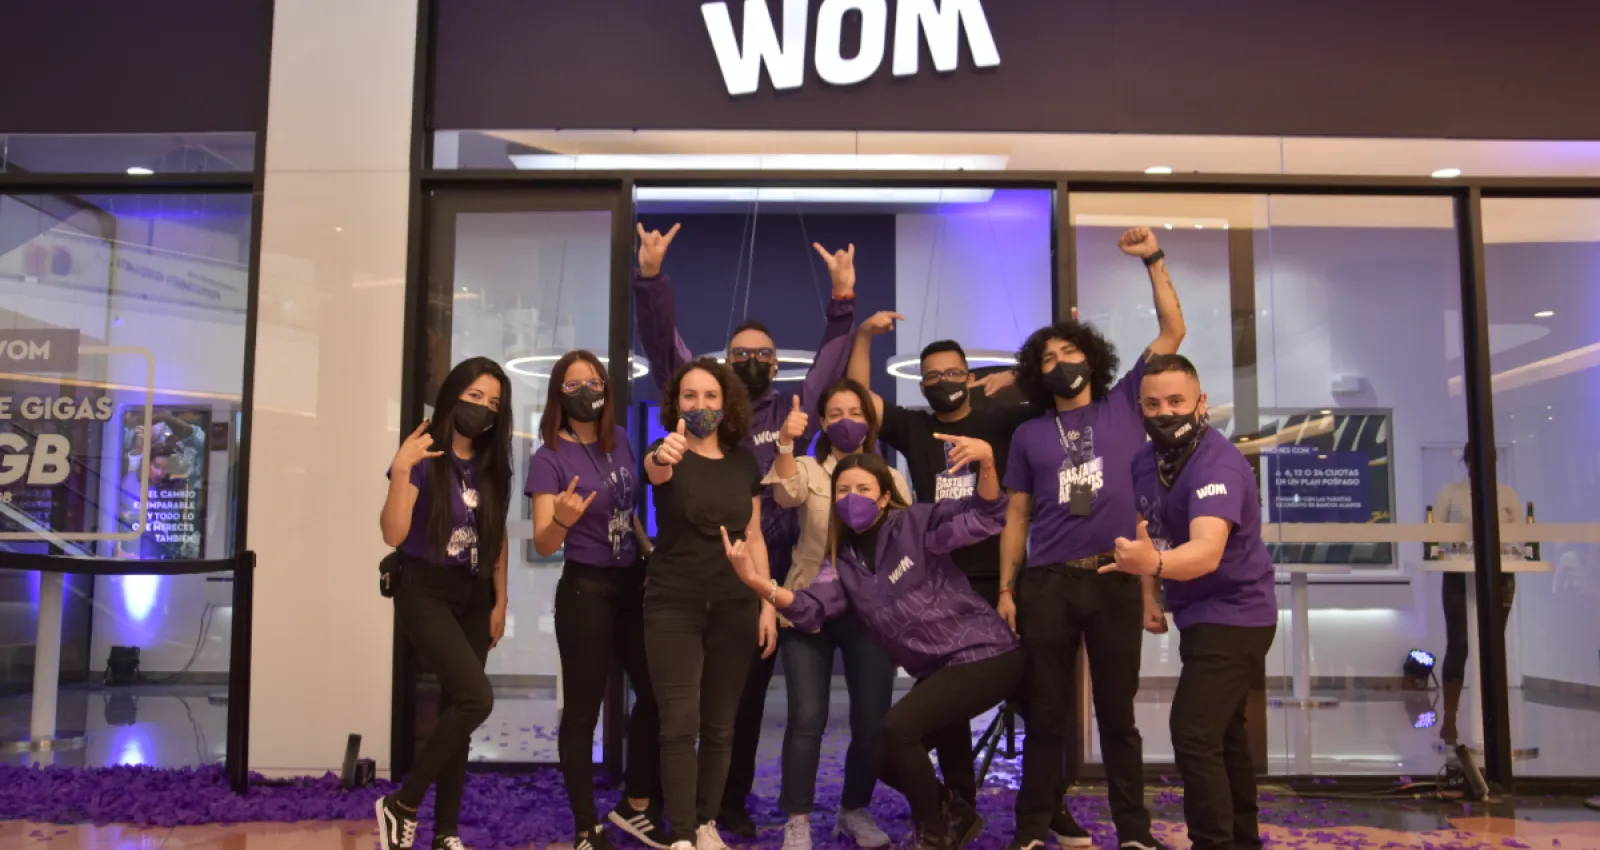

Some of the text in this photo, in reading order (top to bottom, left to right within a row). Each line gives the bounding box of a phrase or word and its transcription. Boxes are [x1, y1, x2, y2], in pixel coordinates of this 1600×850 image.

[701, 0, 1001, 95] WOM
[20, 395, 113, 421] GIGAS
[1174, 422, 1192, 439] WOM
[0, 433, 70, 486] GB
[1325, 468, 1359, 477] CUOTAS
[1300, 478, 1321, 486] PLAN
[148, 490, 158, 499] EL
[1196, 483, 1227, 500] WOM
[155, 512, 180, 520] TODO
[888, 555, 914, 584] WOM
